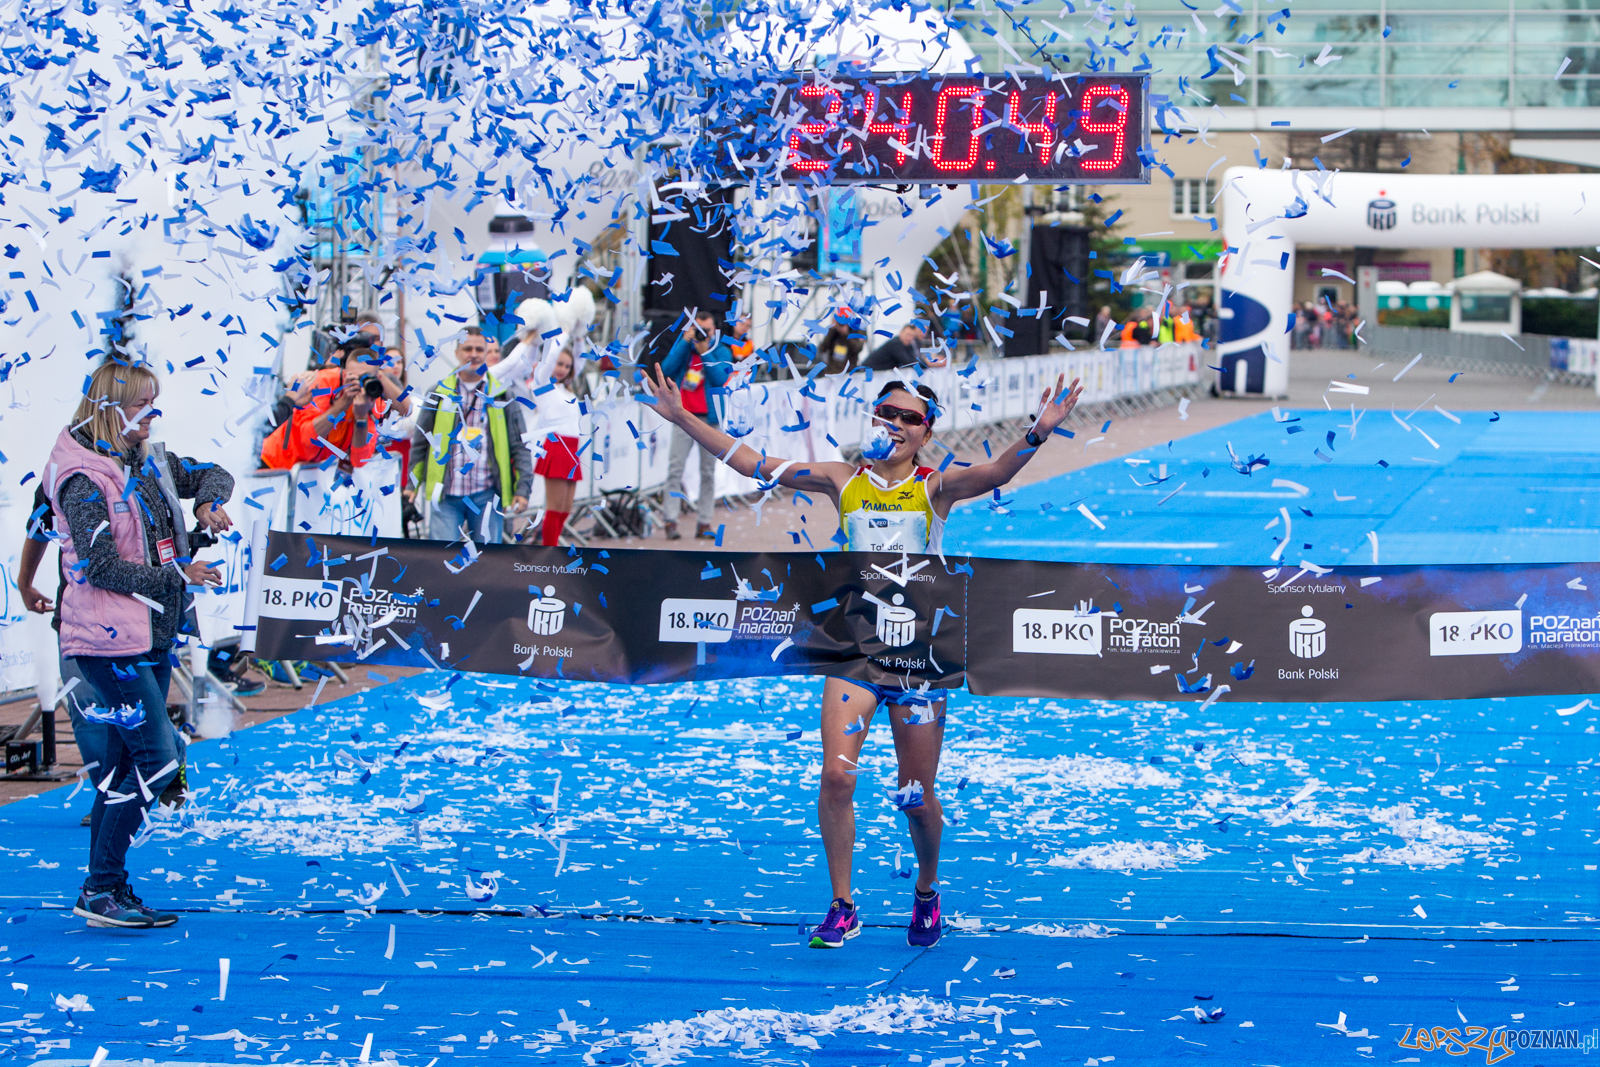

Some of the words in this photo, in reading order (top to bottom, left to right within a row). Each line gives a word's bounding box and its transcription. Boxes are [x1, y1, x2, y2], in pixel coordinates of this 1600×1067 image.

[1411, 202, 1467, 224] Bank
[1476, 202, 1540, 224] Polski
[861, 499, 903, 512] YAMADA
[513, 562, 551, 574] Sponsor
[1267, 583, 1307, 594] Sponsor
[1307, 584, 1347, 594] tytularny
[262, 588, 287, 606] 18.
[291, 591, 333, 608] PKO
[667, 611, 690, 629] 18.
[738, 620, 794, 634] maraton
[1021, 622, 1048, 640] 18.
[1051, 623, 1095, 641] PKO
[1470, 622, 1514, 641] PKO
[1530, 628, 1600, 644] maraton
[1109, 633, 1181, 648] maraton
[513, 643, 540, 655] Bank
[542, 645, 574, 658] Polski
[895, 657, 926, 670] Polski
[1278, 668, 1305, 680] Bank
[1308, 668, 1339, 680] Polski
